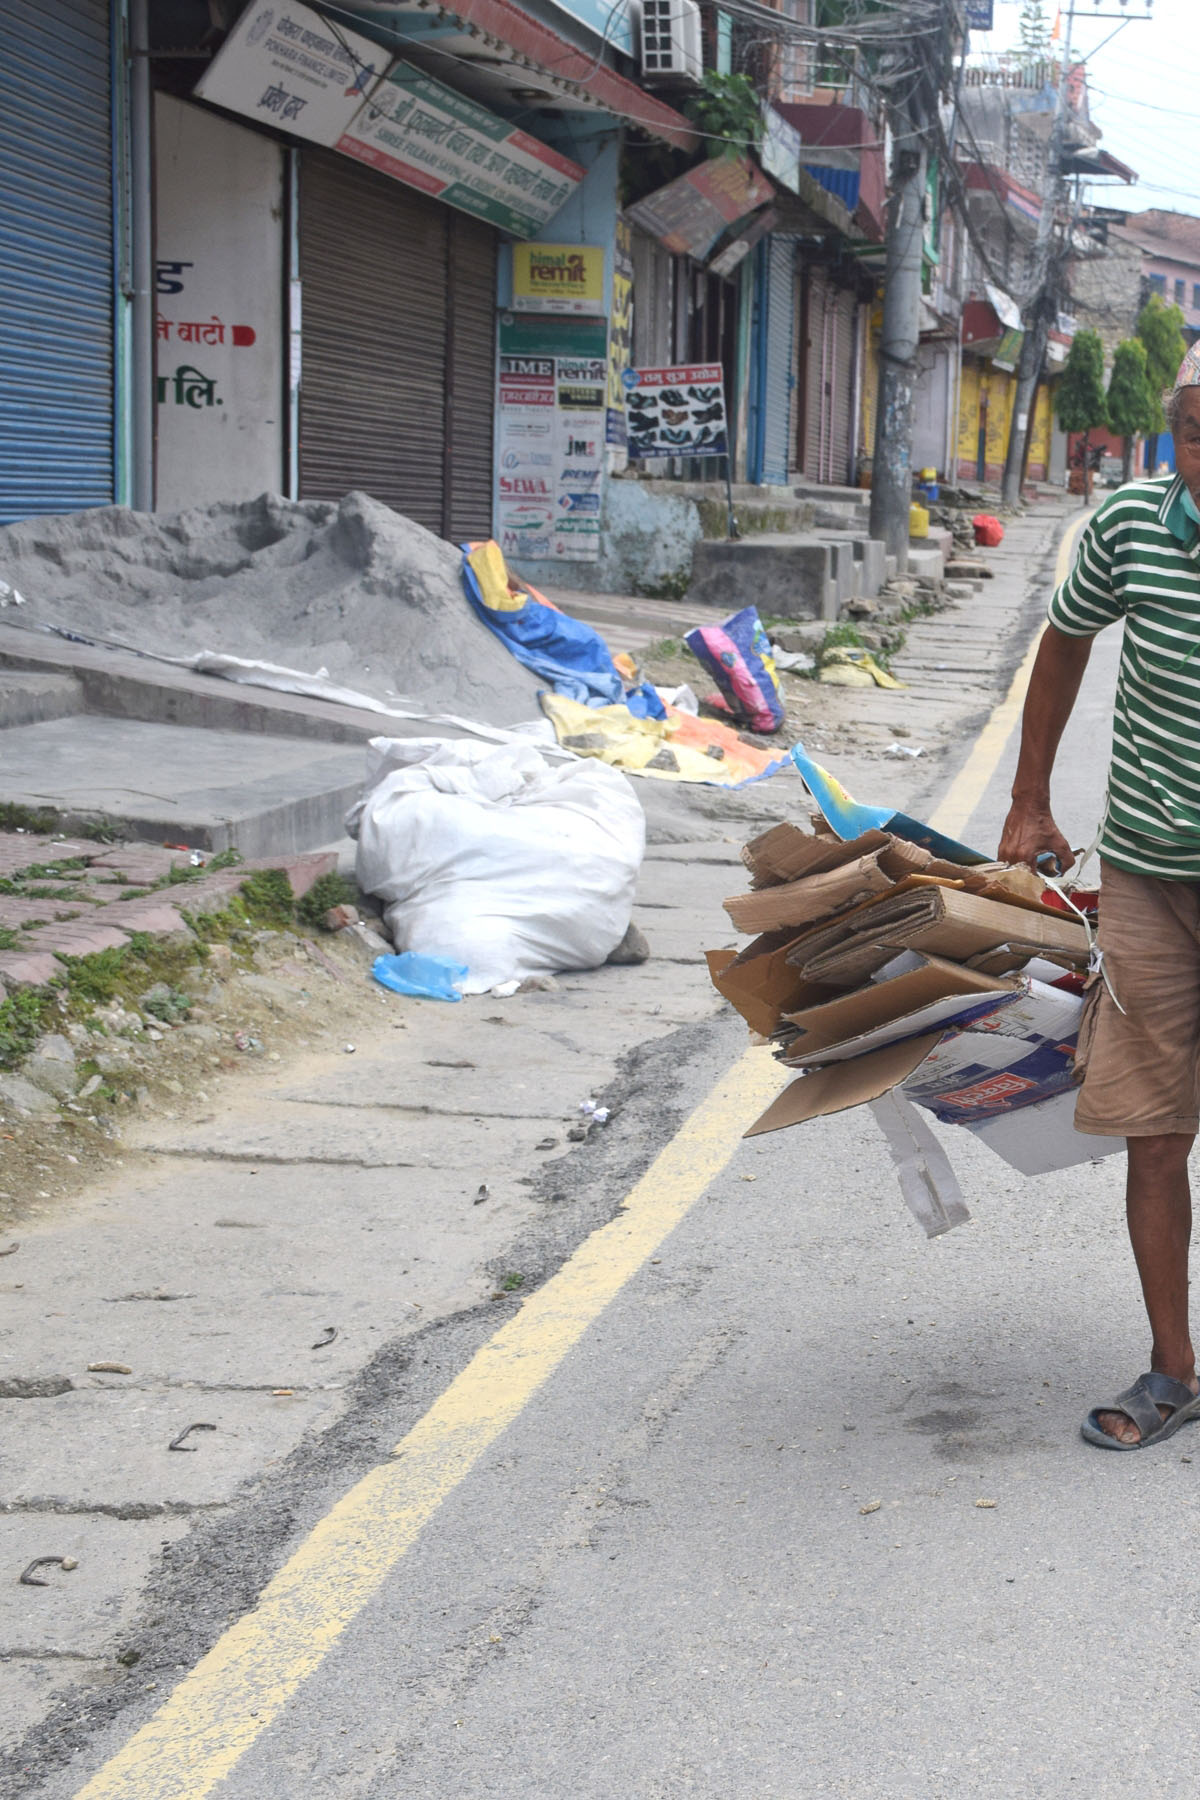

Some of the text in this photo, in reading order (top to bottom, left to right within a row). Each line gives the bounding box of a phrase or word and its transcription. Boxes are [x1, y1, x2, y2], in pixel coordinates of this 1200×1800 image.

[529, 254, 587, 282] remit
[509, 360, 552, 376] IME
[558, 361, 607, 380] remit
